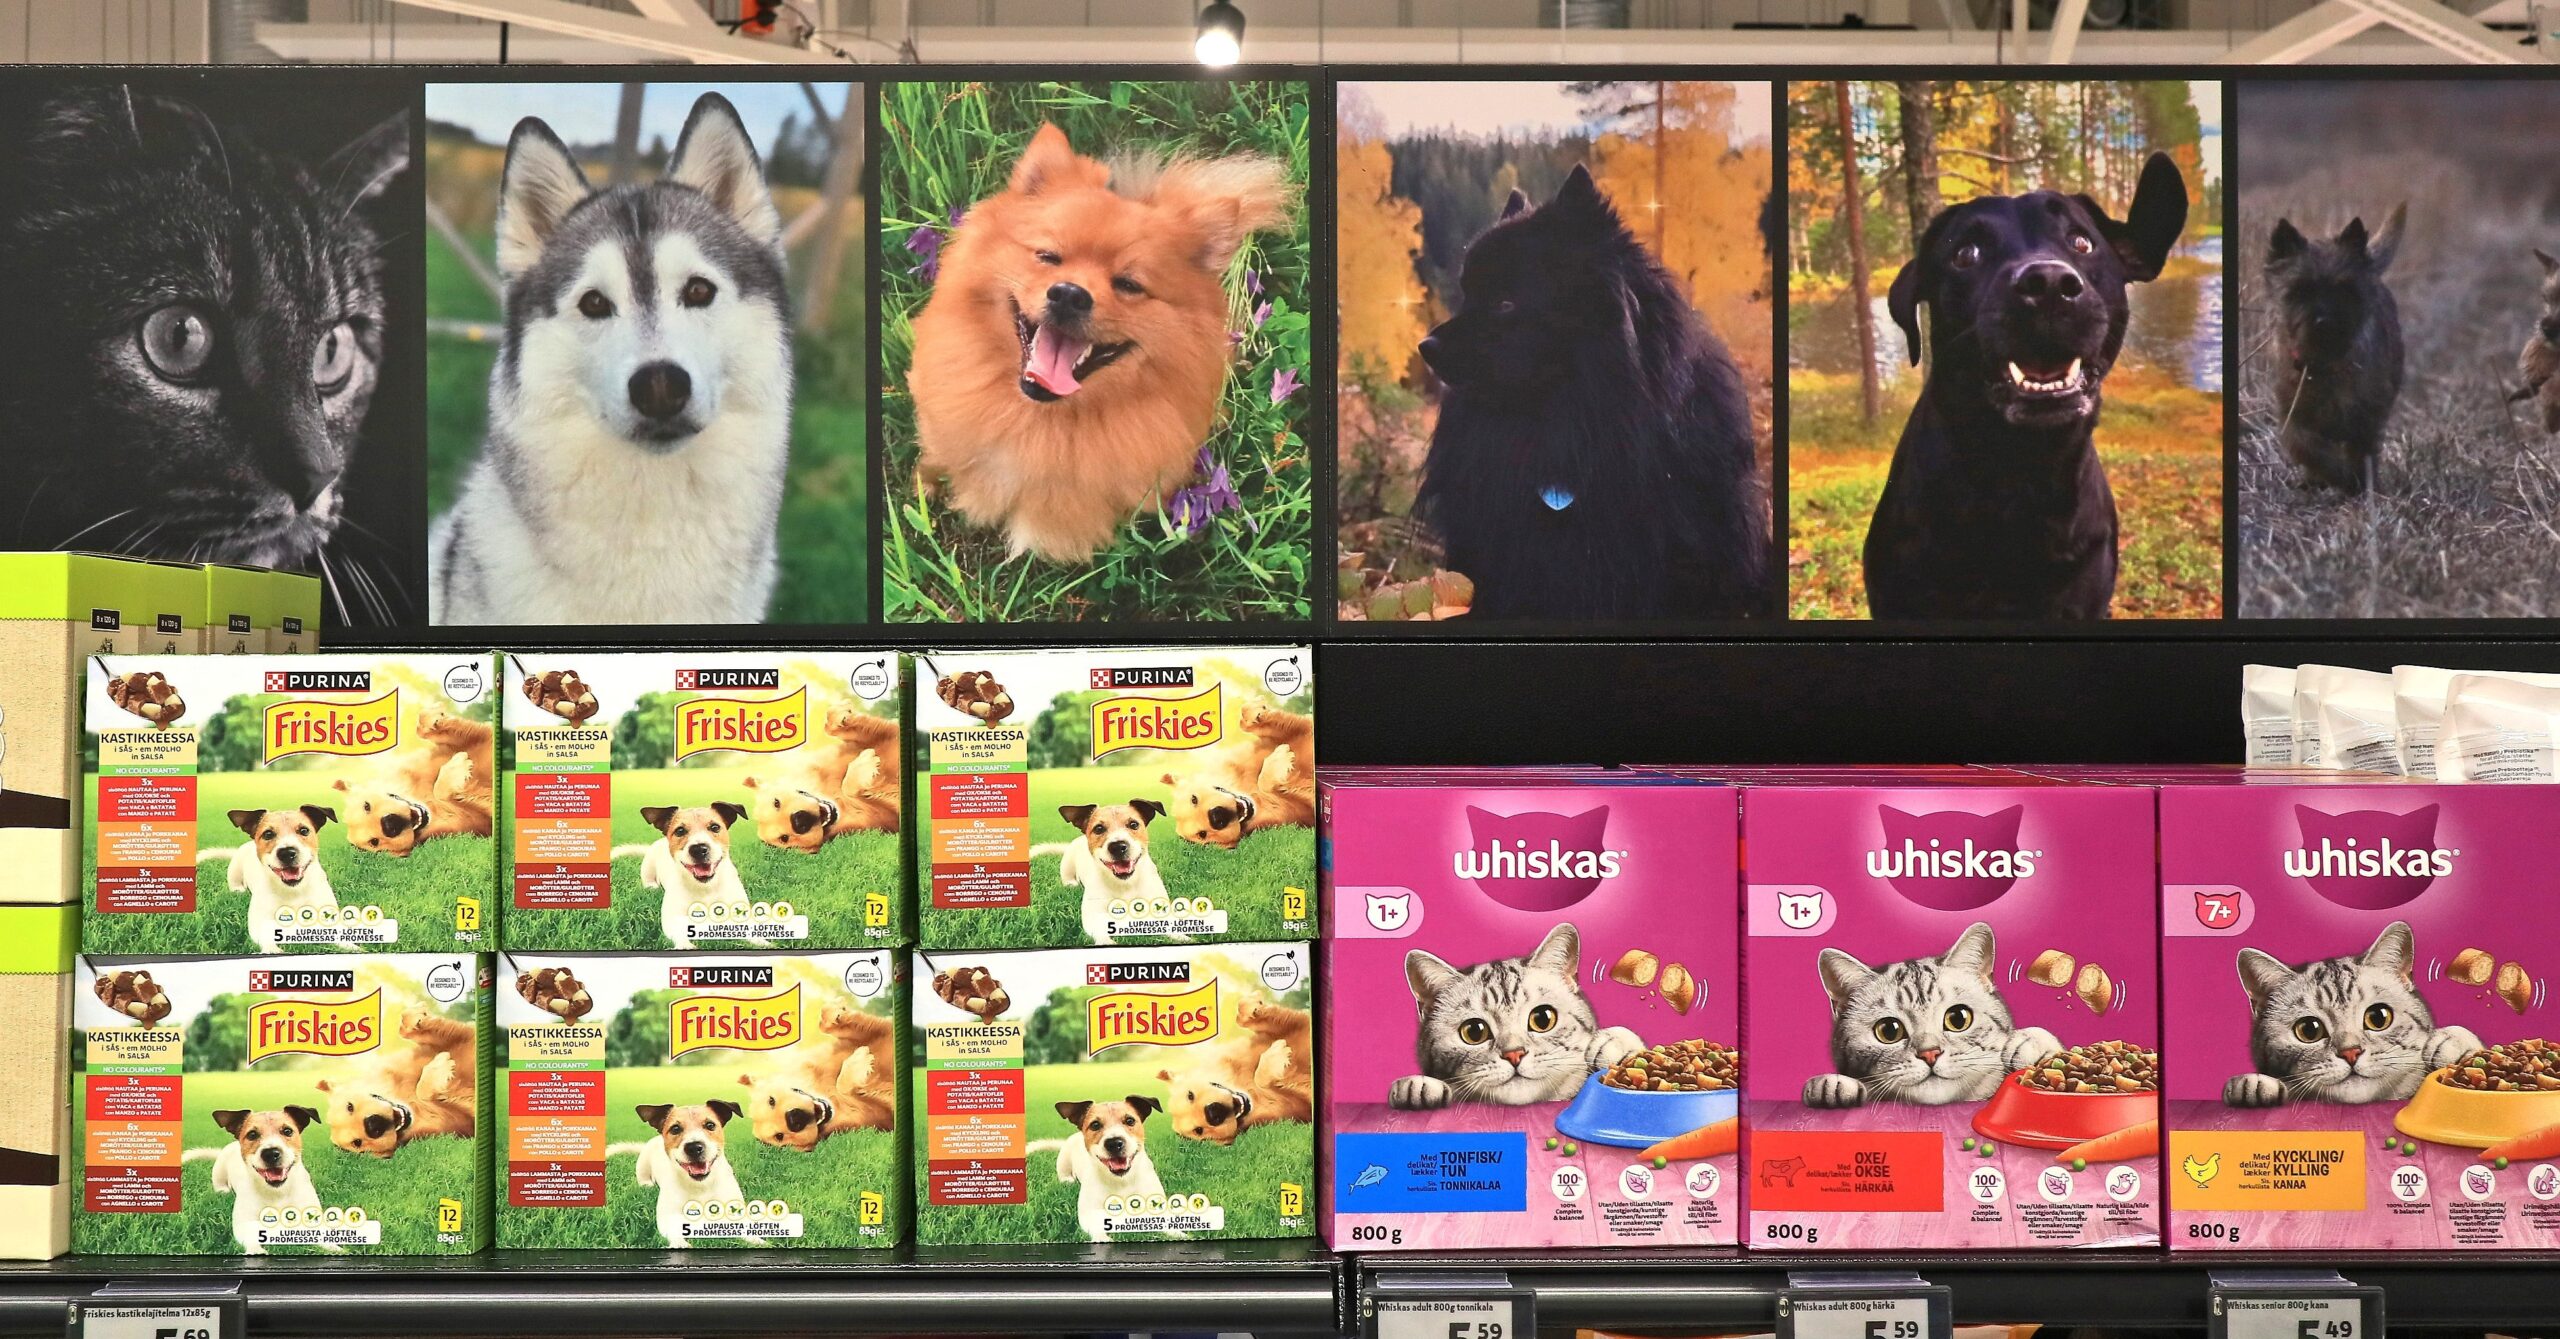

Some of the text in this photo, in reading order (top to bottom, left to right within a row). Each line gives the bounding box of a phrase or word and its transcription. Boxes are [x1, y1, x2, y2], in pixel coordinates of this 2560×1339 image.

[275, 711, 389, 747] Friskies
[686, 708, 797, 745] Friskies
[1103, 706, 1213, 743] Friskies
[101, 732, 195, 743] KASTIKKEESSA
[517, 730, 608, 742] KASTIKKEESSA
[932, 730, 1024, 742] KASTIKKEESSA
[141, 778, 153, 786] 3x
[1288, 897, 1301, 909] 12
[461, 908, 474, 920] 12
[870, 904, 883, 915] 12
[1378, 905, 1398, 921] 1+
[1790, 903, 1810, 919] 1+
[2205, 900, 2231, 921] 7+
[343, 927, 373, 935] LÖFTEN
[687, 926, 696, 937] 5
[1107, 922, 1116, 934] 5
[274, 929, 283, 942] 5
[681, 1006, 792, 1043] Friskies
[1099, 1002, 1210, 1040] Friskies
[260, 1010, 372, 1048] Friskies
[511, 1028, 602, 1038] KASTIKKEESSA
[928, 1026, 1020, 1038] KASTIKKEESSA
[88, 1032, 180, 1042] KASTIKKEESSA
[1440, 1151, 1502, 1163] TONFISK/
[1855, 1152, 1886, 1164] OXE/
[2273, 1151, 2344, 1163] KYCKLING/
[1440, 1165, 1466, 1177] TUN
[2240, 1161, 2270, 1169] delikat/
[2274, 1164, 2329, 1176] KYLLING
[1855, 1166, 1890, 1177] OKSE
[1440, 1181, 1501, 1190] TONNIKALAA
[1855, 1181, 1894, 1192] HÄRKÄÄ
[2274, 1180, 2306, 1189] KANAA
[1285, 1193, 1298, 1205] 12
[865, 1202, 878, 1214] 12
[443, 1210, 456, 1221] 12
[682, 1224, 691, 1236] 5
[1104, 1219, 1112, 1230] 5
[258, 1231, 267, 1243] 5
[1352, 1226, 1401, 1244] 800 g
[1768, 1224, 1817, 1243] 800 g
[2189, 1224, 2239, 1242] 800 g
[1378, 1302, 1493, 1313] Whiskas adult 800g tonnikala
[1794, 1302, 1895, 1312] Whiskas adult 800g härkä
[2228, 1302, 2260, 1310] Whiskas
[2288, 1302, 2309, 1311] 800g
[84, 1308, 210, 1318] Friskies kastikelajitelma 12x85g
[1478, 1324, 1502, 1339] 59
[1895, 1322, 1918, 1338] 59
[2326, 1321, 2352, 1337] 49
